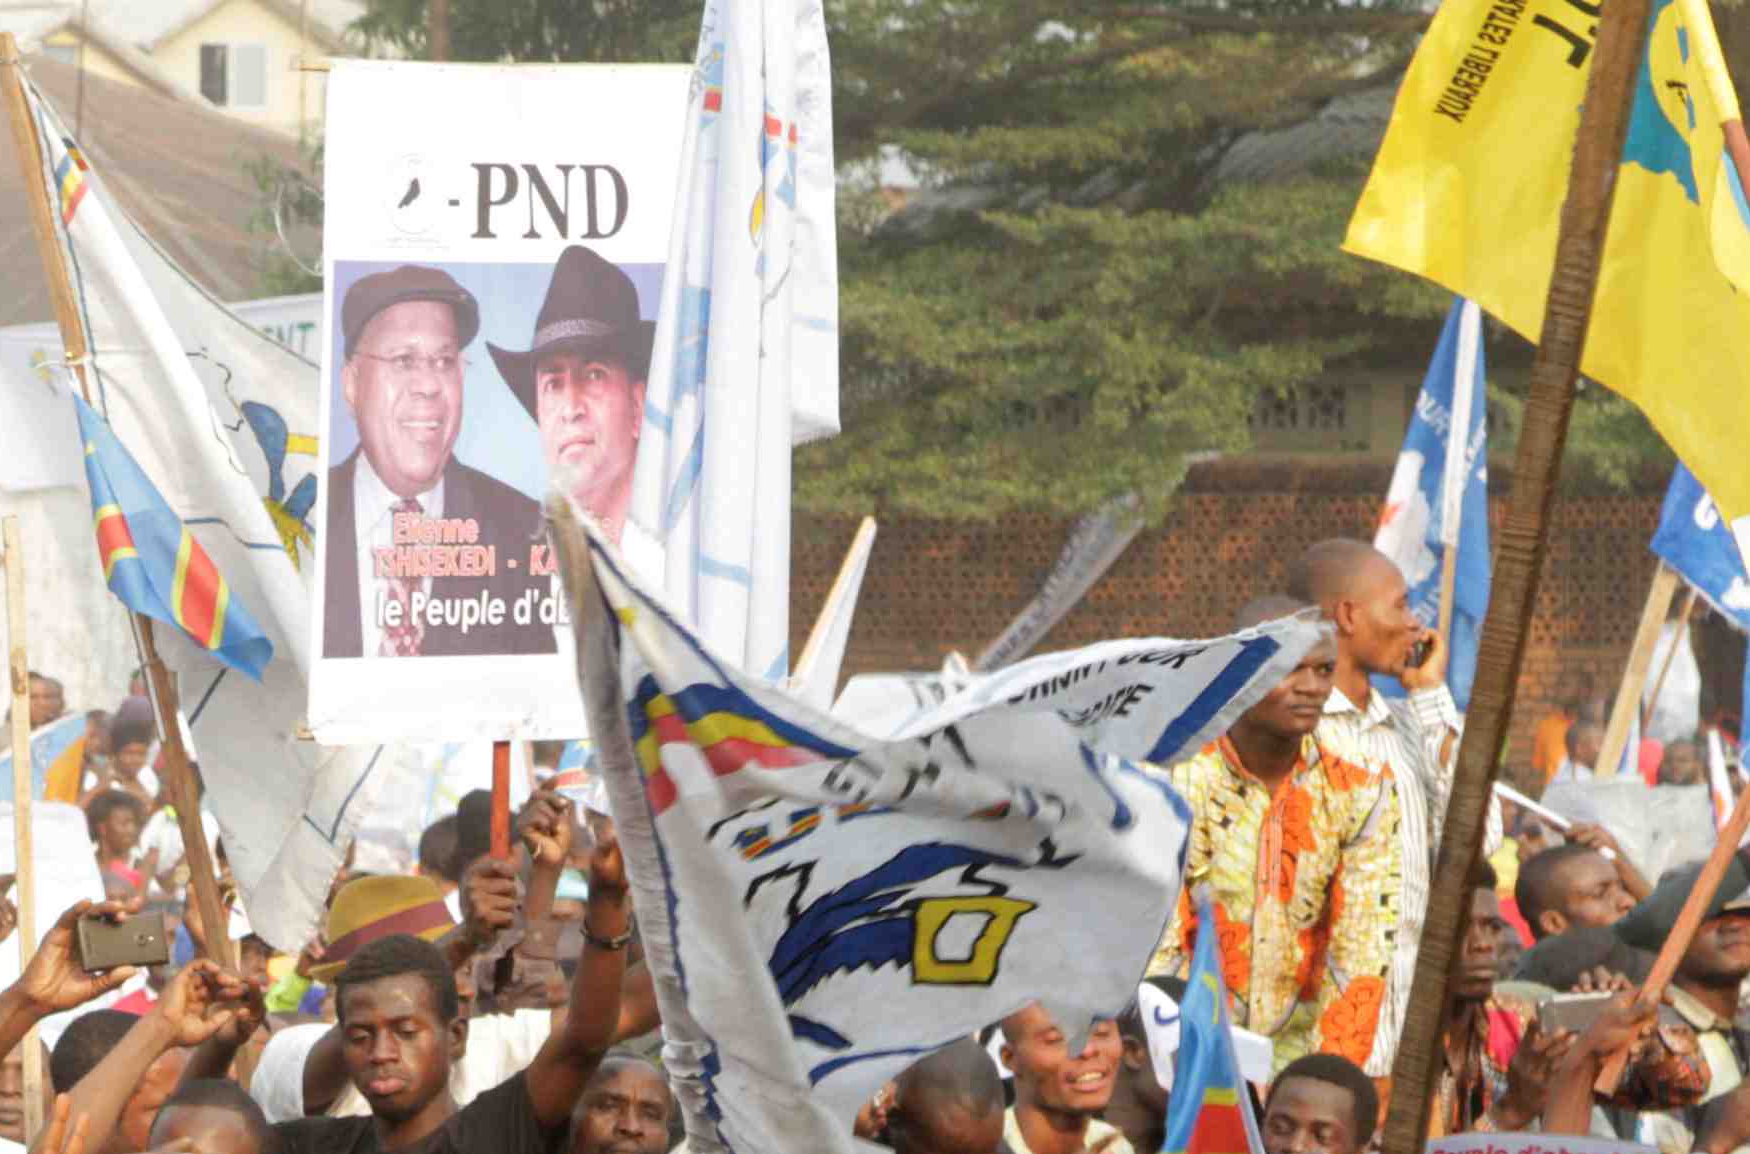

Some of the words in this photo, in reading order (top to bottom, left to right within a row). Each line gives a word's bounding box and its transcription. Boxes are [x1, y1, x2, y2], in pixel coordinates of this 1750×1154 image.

[392, 510, 480, 545] Etienne
[371, 544, 497, 578] TSHISEKEDI
[376, 586, 403, 628] le
[410, 587, 507, 635] Peuple
